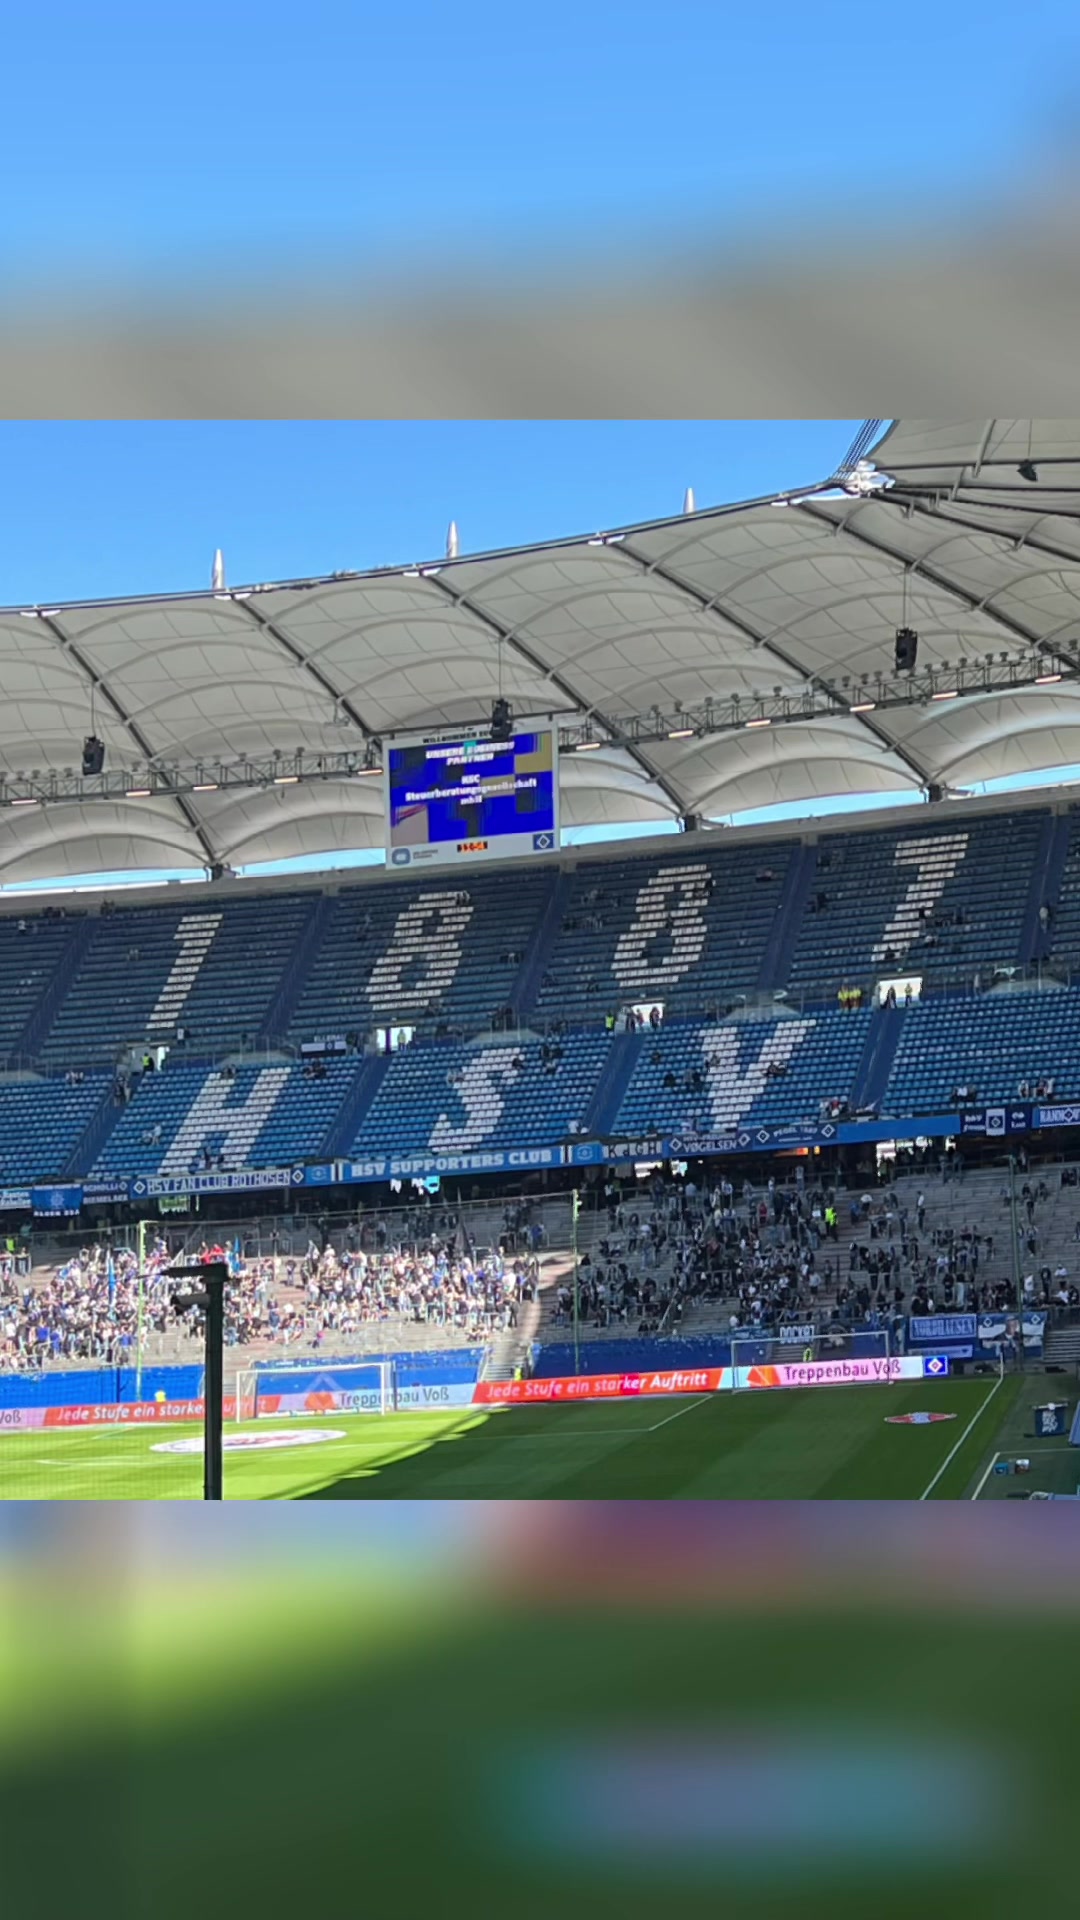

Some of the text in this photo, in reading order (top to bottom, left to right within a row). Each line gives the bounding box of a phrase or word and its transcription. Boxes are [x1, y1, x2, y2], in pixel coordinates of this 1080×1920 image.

[446, 753, 494, 766] PARTNER
[352, 1150, 552, 1178] HSV SUPPORTERS CLUB
[147, 1172, 290, 1193] HSV FAN CLUB ROTHOSEN
[913, 1318, 973, 1337] NORDHAUSEN
[783, 1356, 902, 1382] Treppenbau Voß
[423, 1386, 450, 1402] Voß
[487, 1371, 708, 1399] Jede Stufe ein starker Auftritt
[57, 1401, 205, 1423] Jede Stufe ein starke
